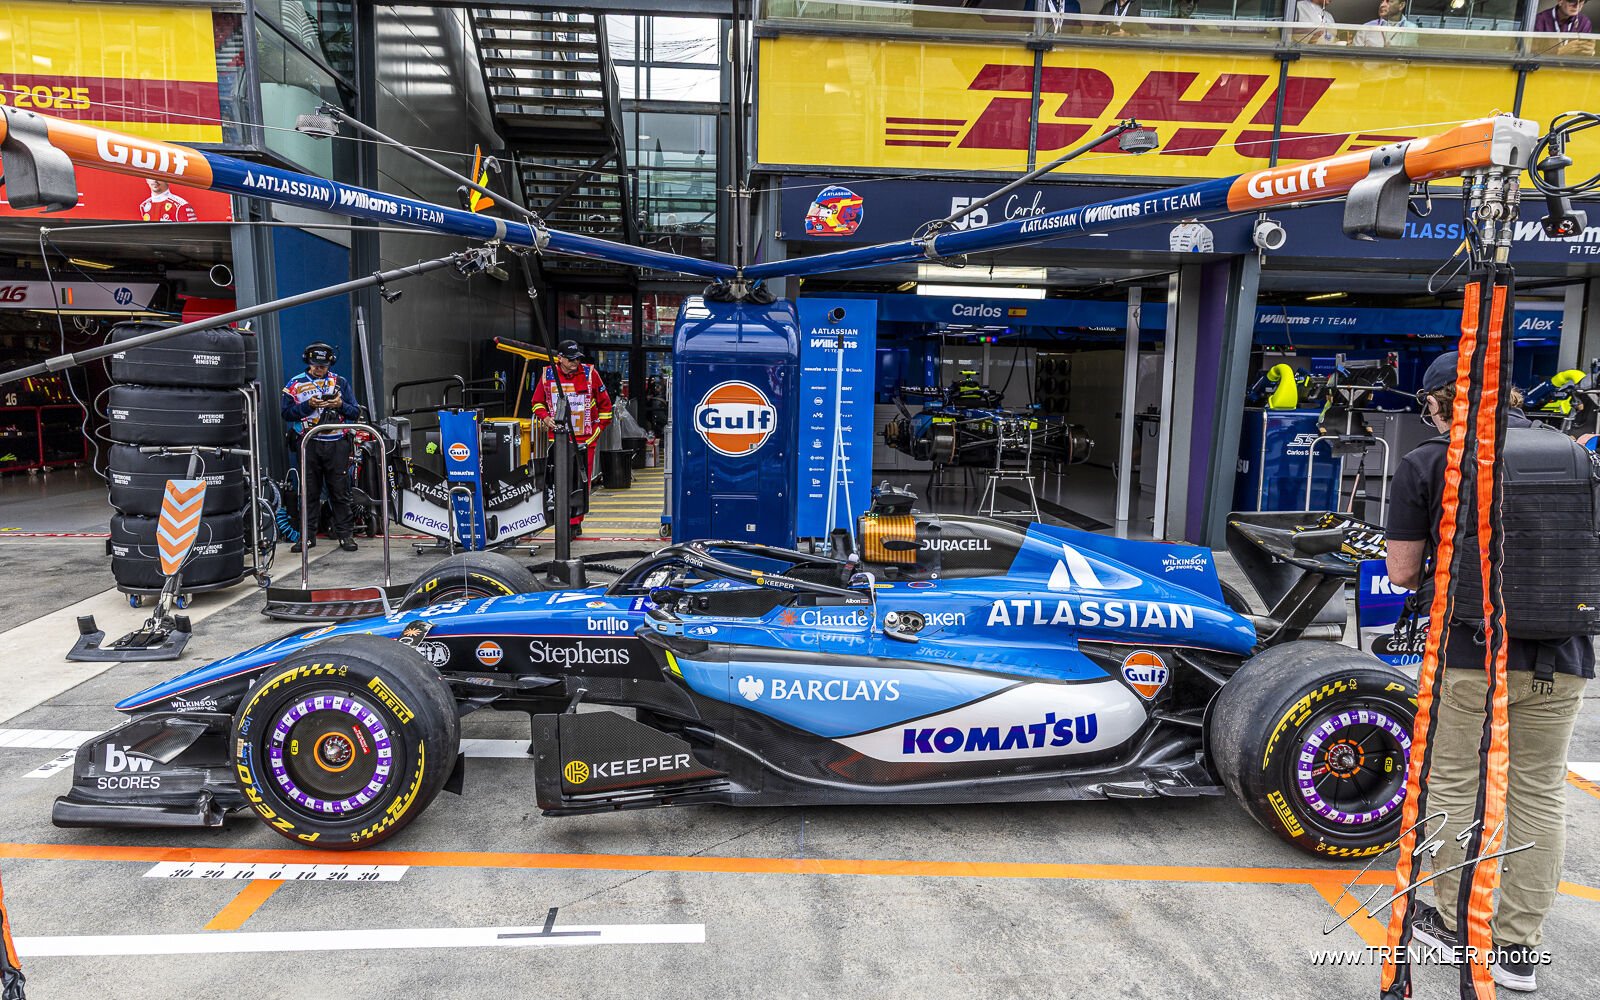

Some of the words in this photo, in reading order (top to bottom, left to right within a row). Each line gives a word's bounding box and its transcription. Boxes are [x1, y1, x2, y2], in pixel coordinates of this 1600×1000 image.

[12, 85, 90, 110] 2025
[958, 64, 1349, 159] DHL
[96, 131, 188, 175] Gulf
[1247, 164, 1329, 199] Gulf
[256, 175, 330, 202] ATLASSIAN
[340, 188, 398, 215] Williams
[401, 204, 412, 218] F1
[415, 206, 444, 224] TEAM
[950, 196, 989, 231] 55
[1027, 212, 1077, 232] ATLASSIAN
[1085, 202, 1140, 223] Williams
[1144, 200, 1158, 213] F1
[1162, 192, 1201, 211] TEAM
[1570, 246, 1581, 254] F1
[0, 286, 28, 302] 16
[116, 288, 131, 305] hp
[952, 303, 1001, 317] Carlos
[1260, 314, 1310, 325] Williams
[1313, 316, 1324, 324] F1
[1327, 317, 1357, 325] TEAM
[1518, 318, 1554, 330] Alex
[5, 393, 17, 406] 16
[699, 408, 771, 430] Gulf
[414, 482, 449, 501] ATLASS
[488, 483, 533, 507] ATLASSIAN
[509, 512, 545, 531] kraken
[920, 539, 992, 551] DURACELL
[764, 579, 795, 590] KEEPER
[801, 611, 868, 627] Claude
[987, 600, 1195, 629] ATLASSIAN
[587, 616, 629, 635] brillio
[478, 649, 501, 659] Gulf
[529, 640, 630, 668] Stephens
[1124, 668, 1166, 685] Gulf
[771, 679, 900, 701] BARCLAYS
[171, 700, 218, 708] WILKINSON
[367, 676, 415, 724] PIRELLI
[902, 711, 1098, 755] KOMATSU
[105, 744, 154, 773] bw
[592, 753, 691, 778] KEEPER
[97, 777, 161, 789] SCORES
[1267, 790, 1304, 838] PIRELLI
[169, 869, 193, 878] 30
[200, 870, 225, 879] 20
[231, 870, 255, 879] 10
[268, 871, 282, 879] 0
[295, 871, 317, 880] 10
[326, 872, 348, 880] 20
[357, 872, 380, 881] 30
